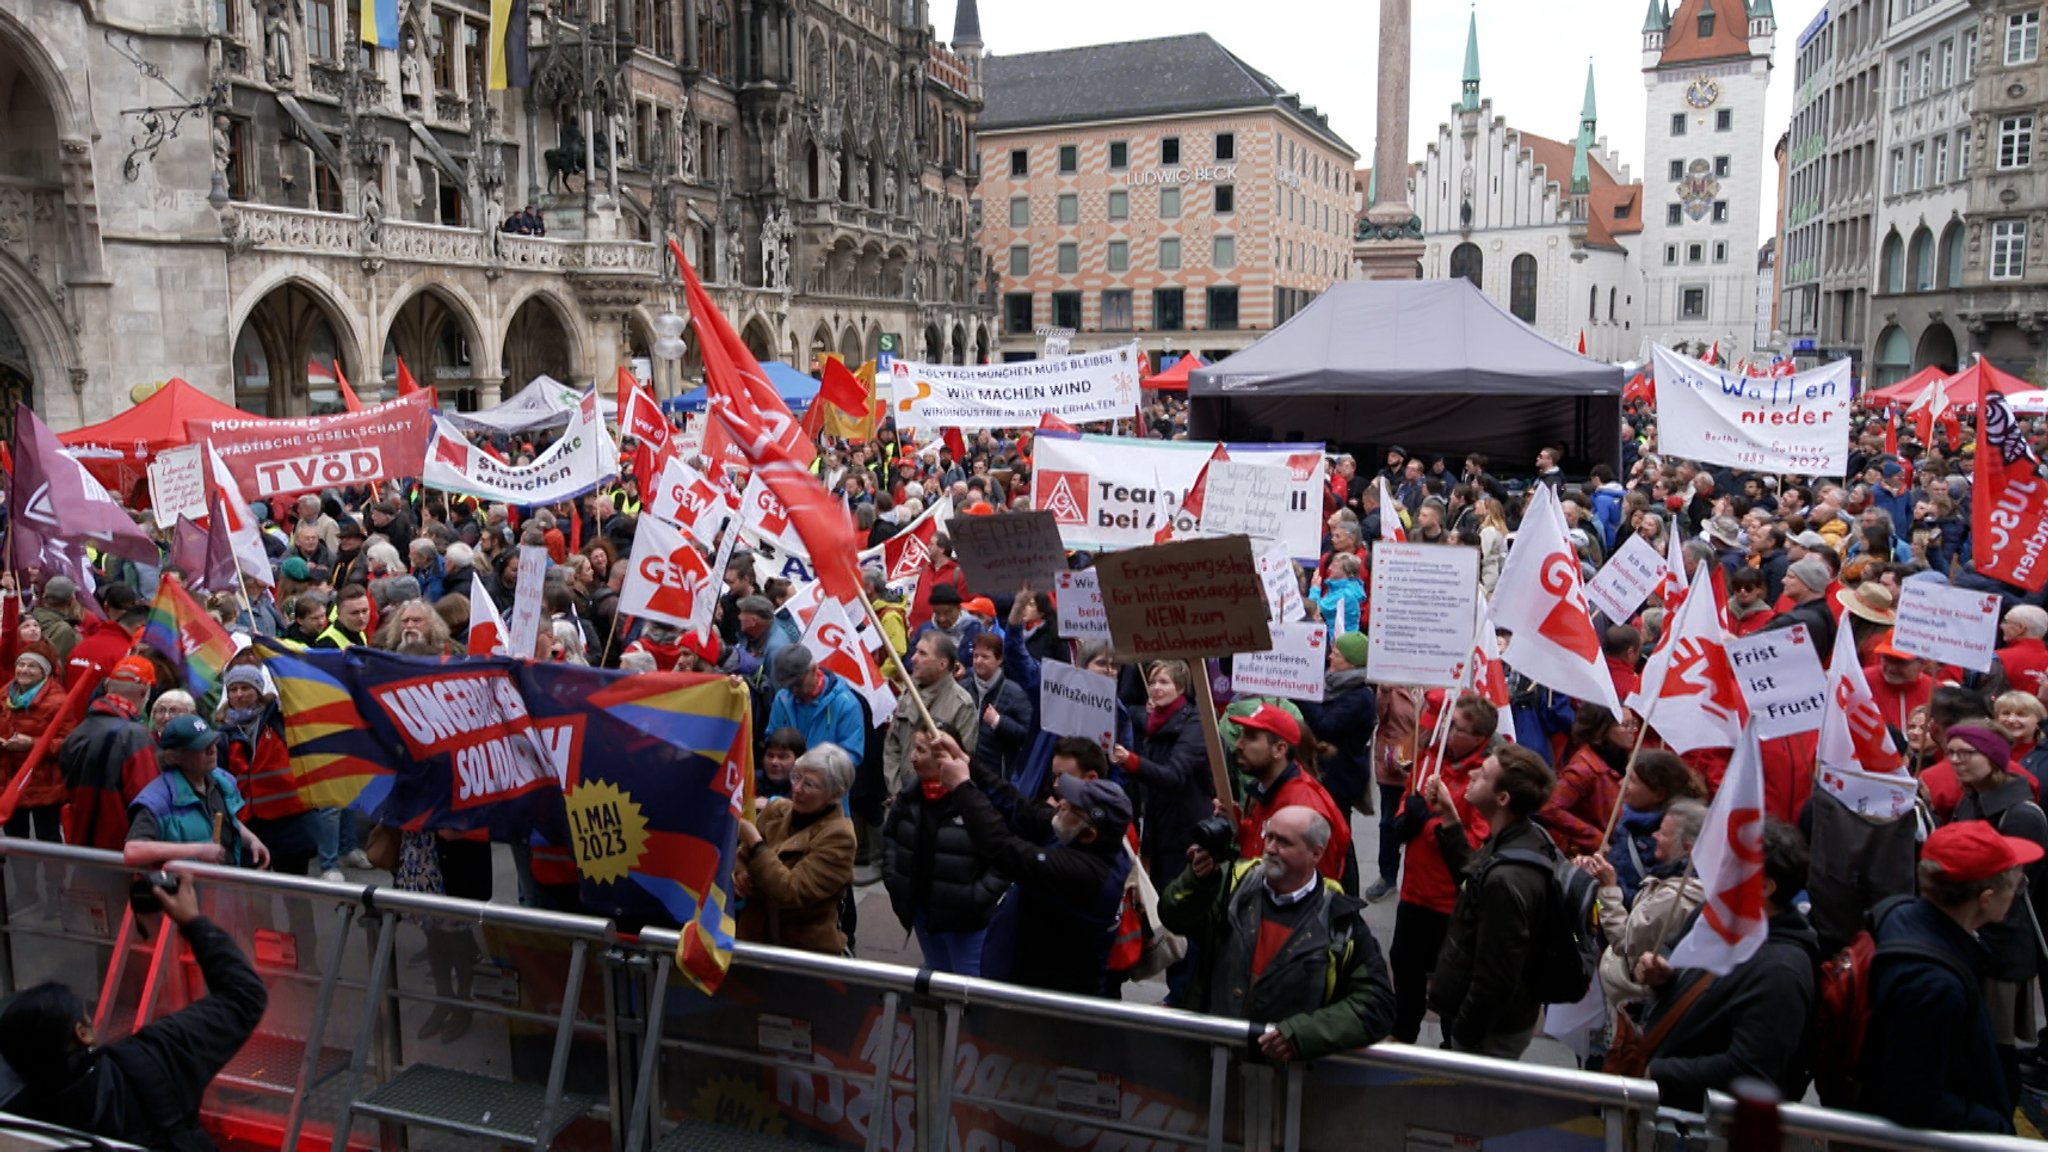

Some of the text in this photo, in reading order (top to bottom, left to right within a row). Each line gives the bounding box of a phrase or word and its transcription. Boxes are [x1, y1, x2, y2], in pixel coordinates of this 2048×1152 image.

[1126, 166, 1237, 187] LUDWIG BECK
[881, 335, 893, 350] S
[882, 354, 892, 369] U
[1035, 361, 1068, 374] MUSS
[1070, 354, 1113, 369] BLEIBEN
[947, 380, 1092, 400] WIR MACHEN WIND
[922, 407, 1002, 417] WINDINDUSTRIE
[1062, 399, 1116, 415] ERHALTEN
[306, 420, 412, 443] GESELLSCHAFT
[1789, 456, 1830, 470] 2022
[476, 464, 572, 492] München
[1098, 509, 1138, 530] bei
[639, 555, 711, 593] GEW
[1074, 578, 1095, 590] Wir
[1145, 605, 1226, 628] NEIN zum
[1131, 626, 1257, 654] Reallohnverlust
[1264, 654, 1310, 667] verlieren,
[1732, 645, 1778, 667] Frist
[1266, 666, 1299, 678] unsere
[1234, 673, 1320, 694] Kettenbefristung!
[1749, 675, 1776, 693] ist
[1766, 691, 1825, 720] Frust!
[578, 829, 627, 862] 2023
